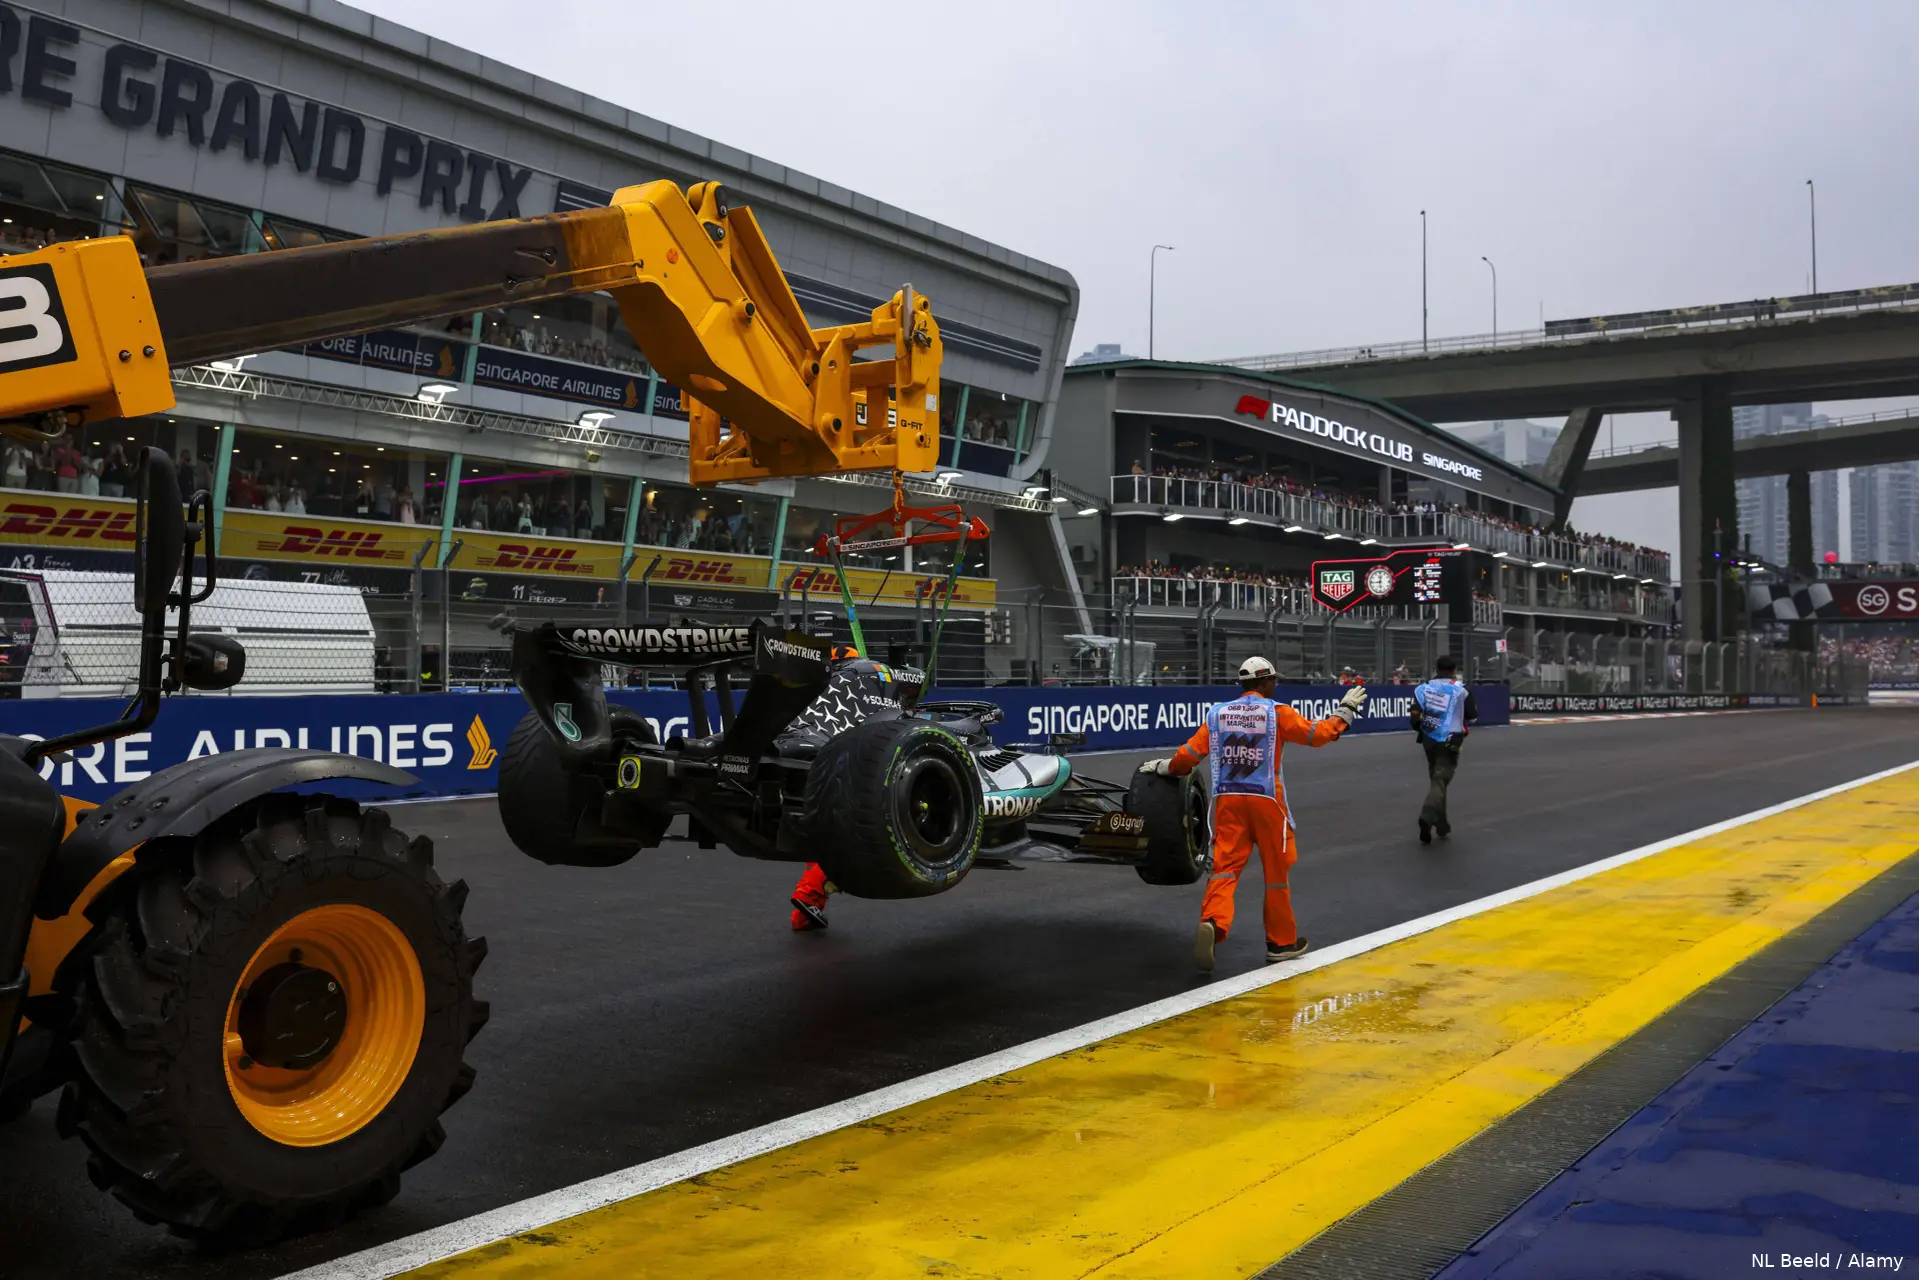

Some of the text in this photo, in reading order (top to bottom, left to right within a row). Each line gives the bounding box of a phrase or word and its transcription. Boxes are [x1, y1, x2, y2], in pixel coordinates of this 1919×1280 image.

[101, 42, 365, 184] GRAND
[377, 126, 532, 221] PRIX
[363, 342, 434, 367] AIRLINES
[476, 363, 621, 401] SINGAPORE AIRLINES
[901, 419, 923, 431] G-FIT
[1272, 402, 1482, 481] PADDOCK CLUB SINGAPORE
[0, 504, 137, 541] DHL
[279, 526, 384, 559] DHL
[495, 544, 577, 573] DHL
[300, 572, 321, 584] 77
[665, 558, 735, 584] DHL
[1324, 574, 1351, 583] TAG
[512, 584, 525, 599] 11
[697, 596, 735, 604] CADILLAC
[1323, 584, 1352, 600] HEUER
[1862, 588, 1918, 611] SG S
[572, 628, 751, 653] CROWDSTRIKE
[768, 638, 821, 662] CROWDSTRIKE
[1028, 703, 1148, 735] SINGAPORE
[1220, 713, 1266, 722] INTERVENTION
[1291, 699, 1363, 720] SINGAPE
[1227, 720, 1256, 728] MARSHAL
[1223, 745, 1264, 762] OURSE
[720, 762, 750, 774] PRIMAX
